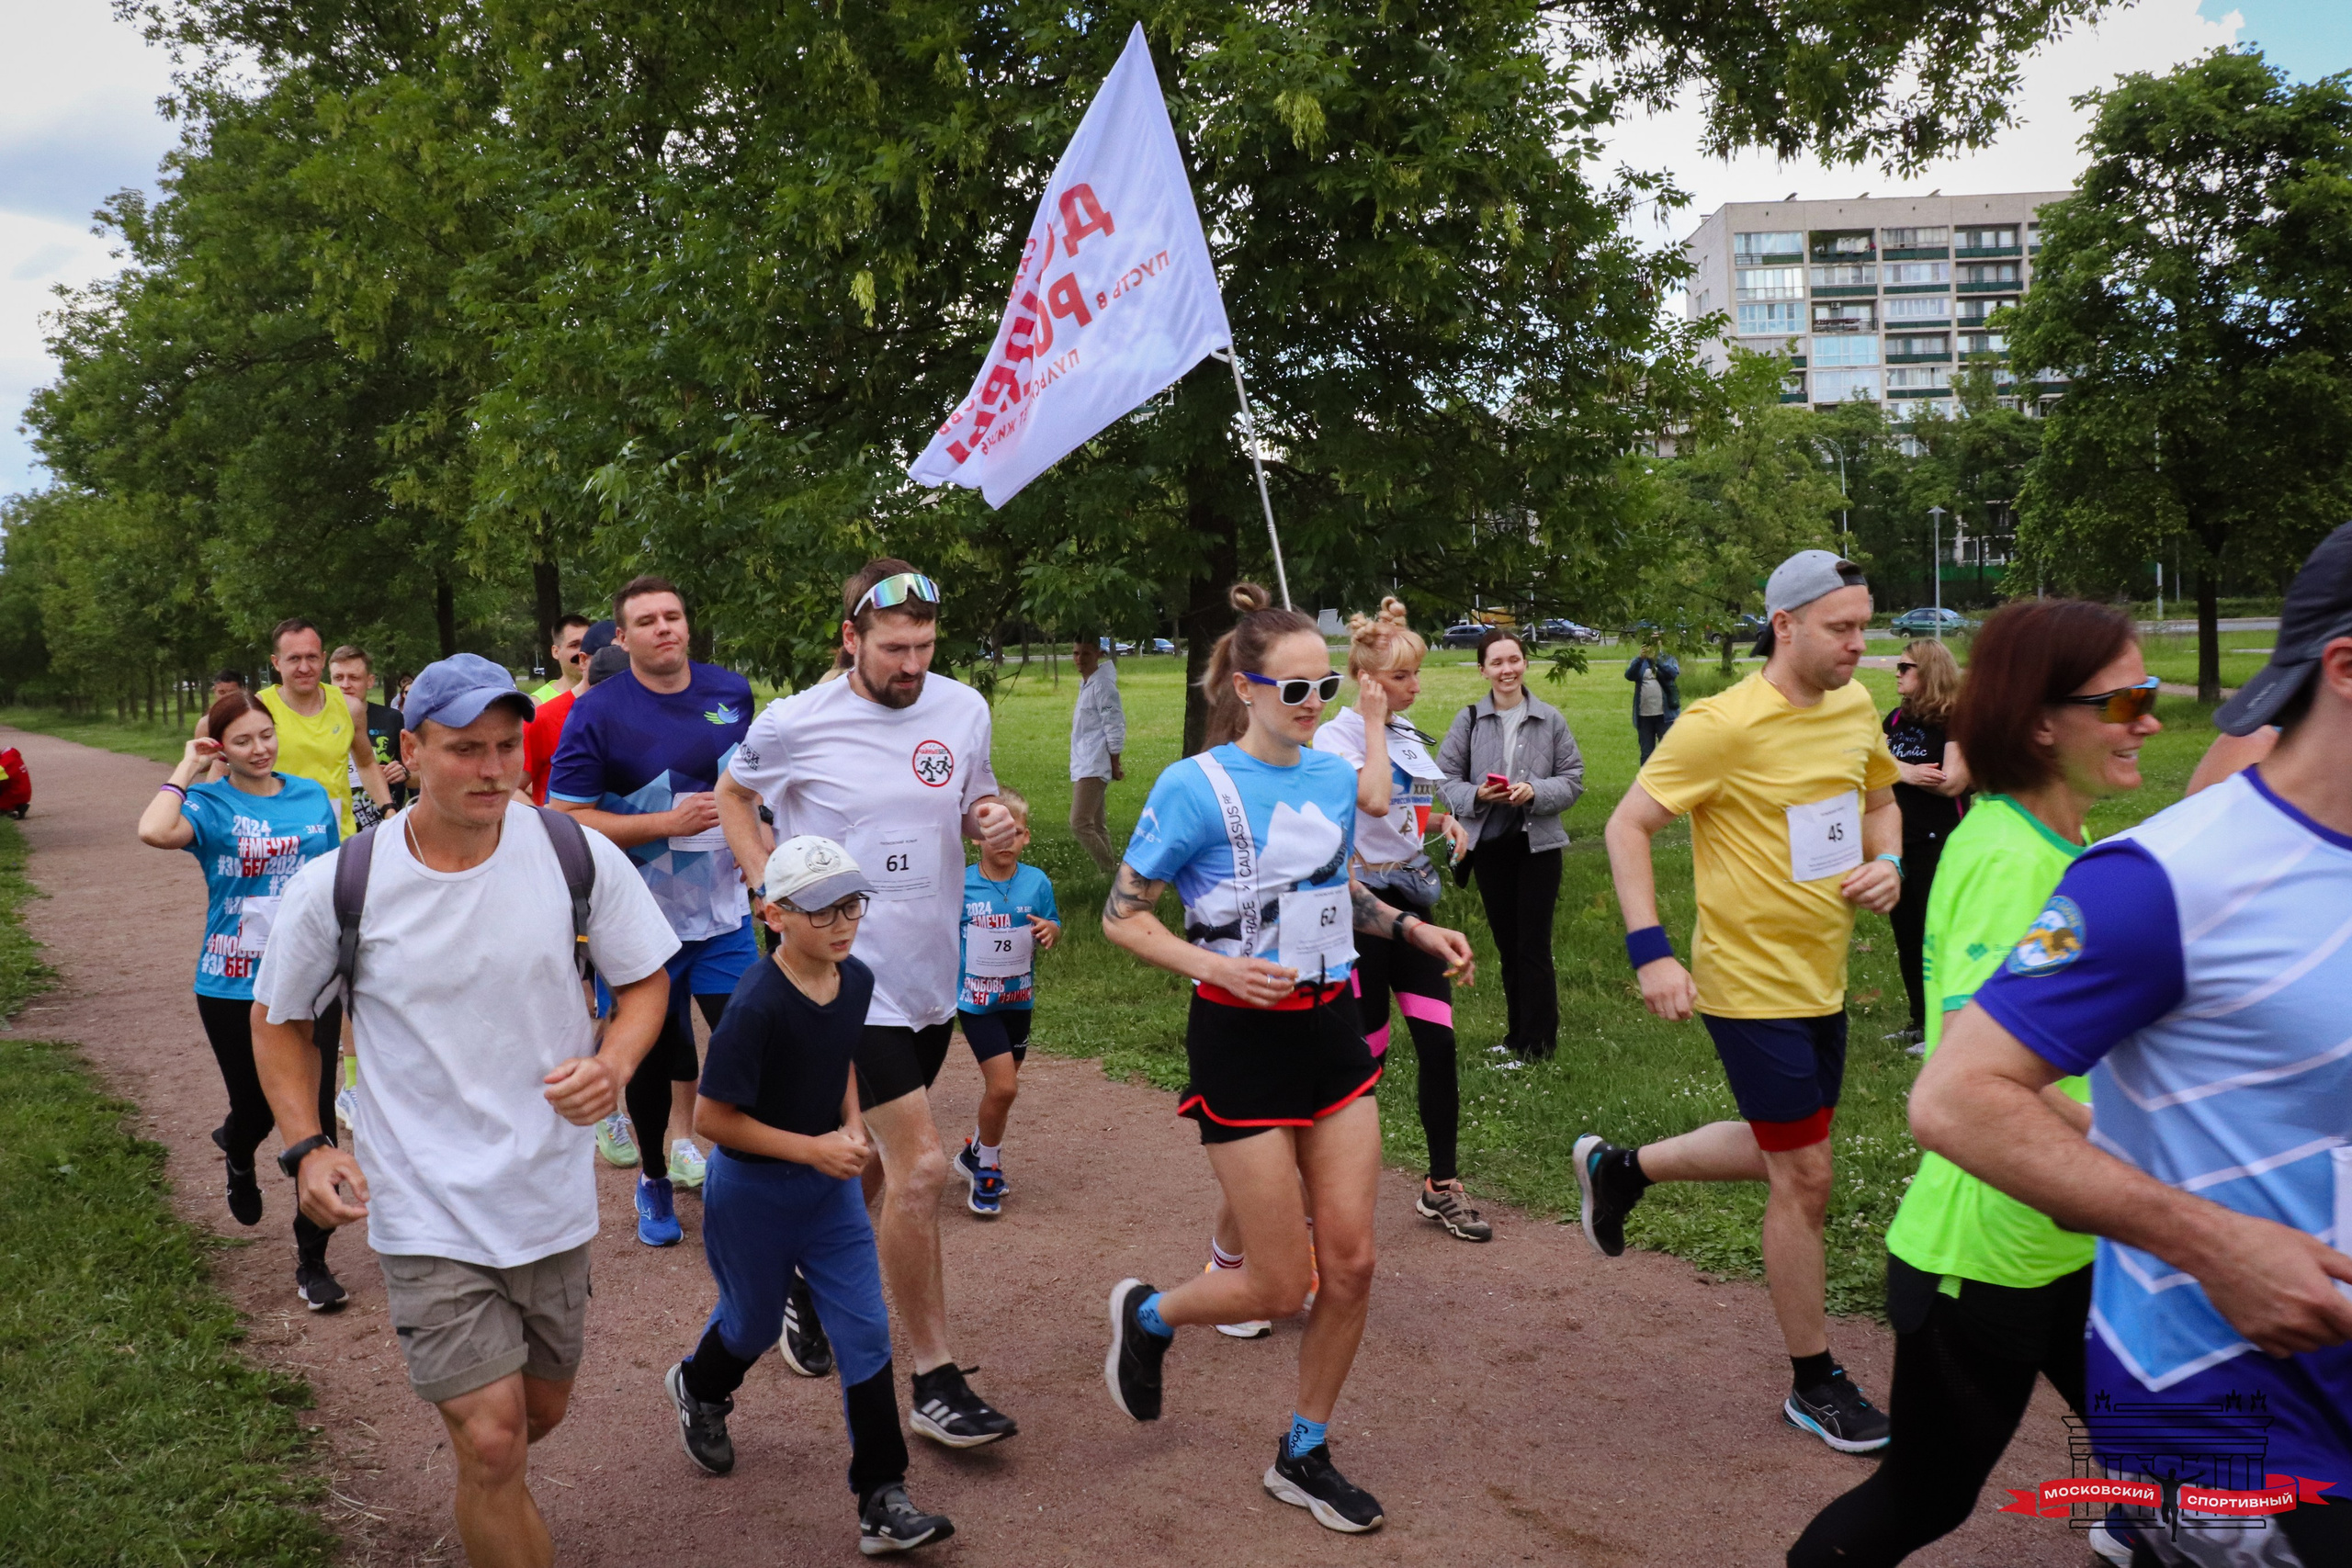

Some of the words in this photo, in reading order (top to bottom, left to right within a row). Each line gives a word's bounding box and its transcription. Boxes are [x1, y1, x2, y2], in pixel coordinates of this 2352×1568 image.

[1402, 749, 1418, 761] 50
[1221, 794, 1232, 805] RF
[231, 815, 272, 837] 2024
[1827, 822, 1844, 843] 45
[238, 836, 300, 858] #МЕЧТА
[1226, 806, 1252, 878] CAUCASUS
[217, 854, 307, 879] #ЗАБЕГ2024
[886, 853, 910, 872] 61
[966, 900, 993, 918] 2024
[1242, 900, 1257, 934] RACE
[1320, 906, 1337, 928] 62
[993, 939, 1012, 953] 78
[200, 952, 254, 978] #ЗАБЕГ
